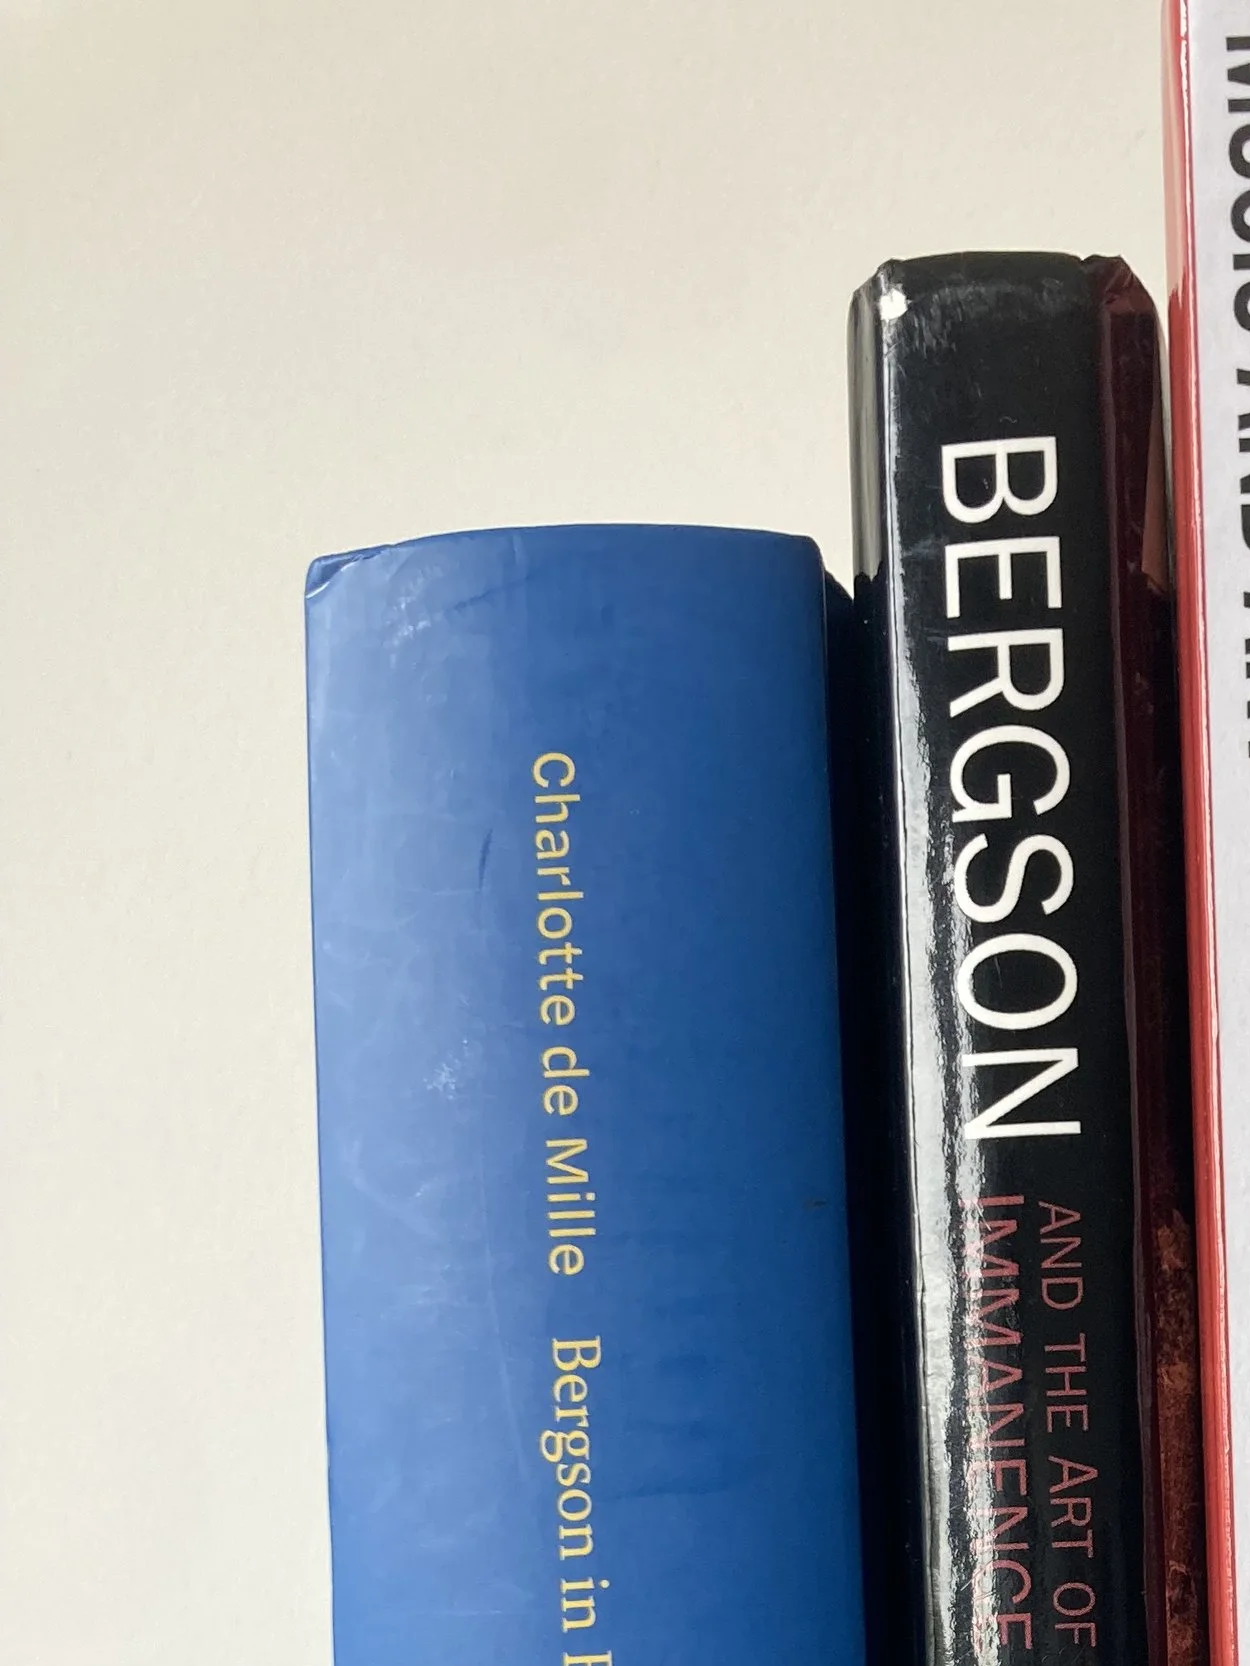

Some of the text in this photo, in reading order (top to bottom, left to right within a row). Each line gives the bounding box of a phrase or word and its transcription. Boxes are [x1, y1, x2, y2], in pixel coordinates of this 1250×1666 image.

[531, 751, 596, 1276] Charlotte de Mille
[939, 435, 1082, 1141] BERGSON
[539, 1337, 602, 1559] Bergson
[559, 1579, 609, 1632] in
[960, 1194, 1033, 1650] IMMANENCE
[1038, 1200, 1098, 1649] AND THE ART OF
